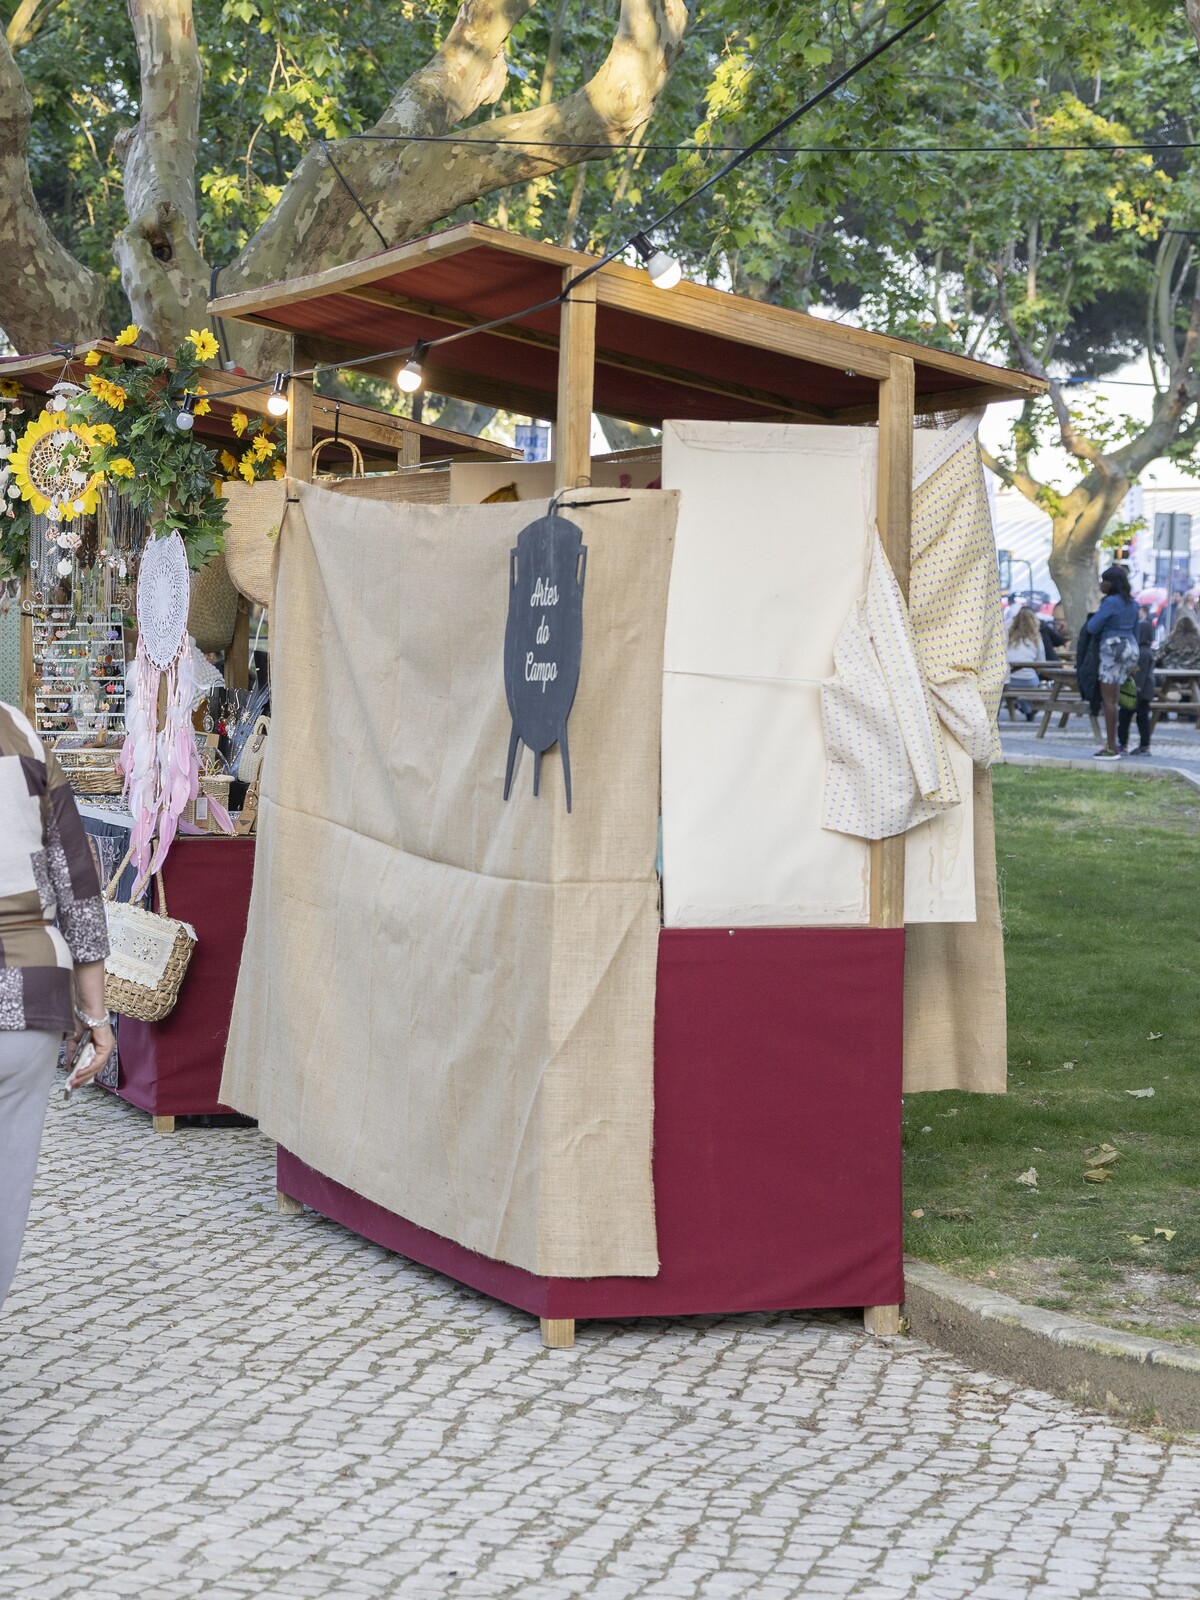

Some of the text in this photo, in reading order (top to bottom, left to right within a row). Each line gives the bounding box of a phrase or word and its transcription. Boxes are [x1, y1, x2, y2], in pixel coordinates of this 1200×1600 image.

[530, 577, 559, 607] Artes
[536, 614, 550, 645] do
[525, 651, 558, 694] Campo
